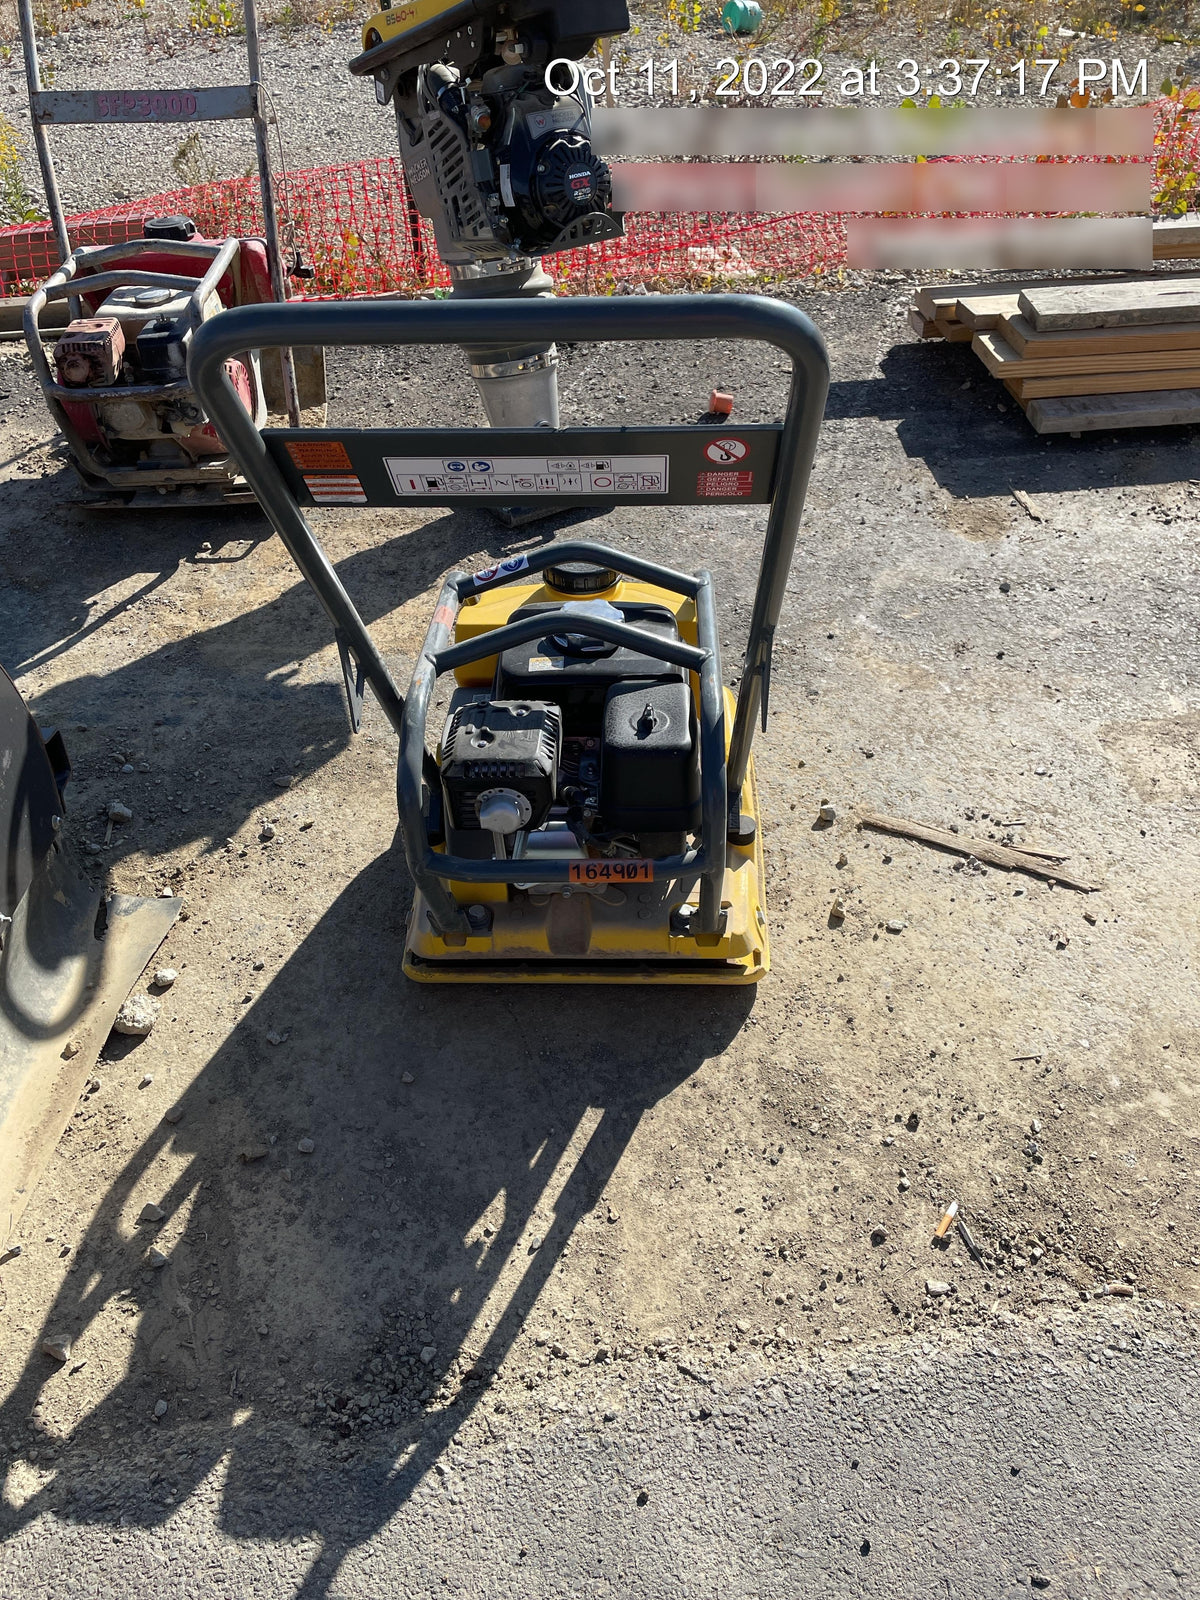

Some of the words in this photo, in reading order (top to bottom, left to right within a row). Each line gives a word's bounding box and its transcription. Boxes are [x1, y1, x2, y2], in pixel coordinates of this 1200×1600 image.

[97, 92, 197, 117] SFP3000
[569, 171, 591, 180] HONDA
[572, 861, 649, 880] 164901
